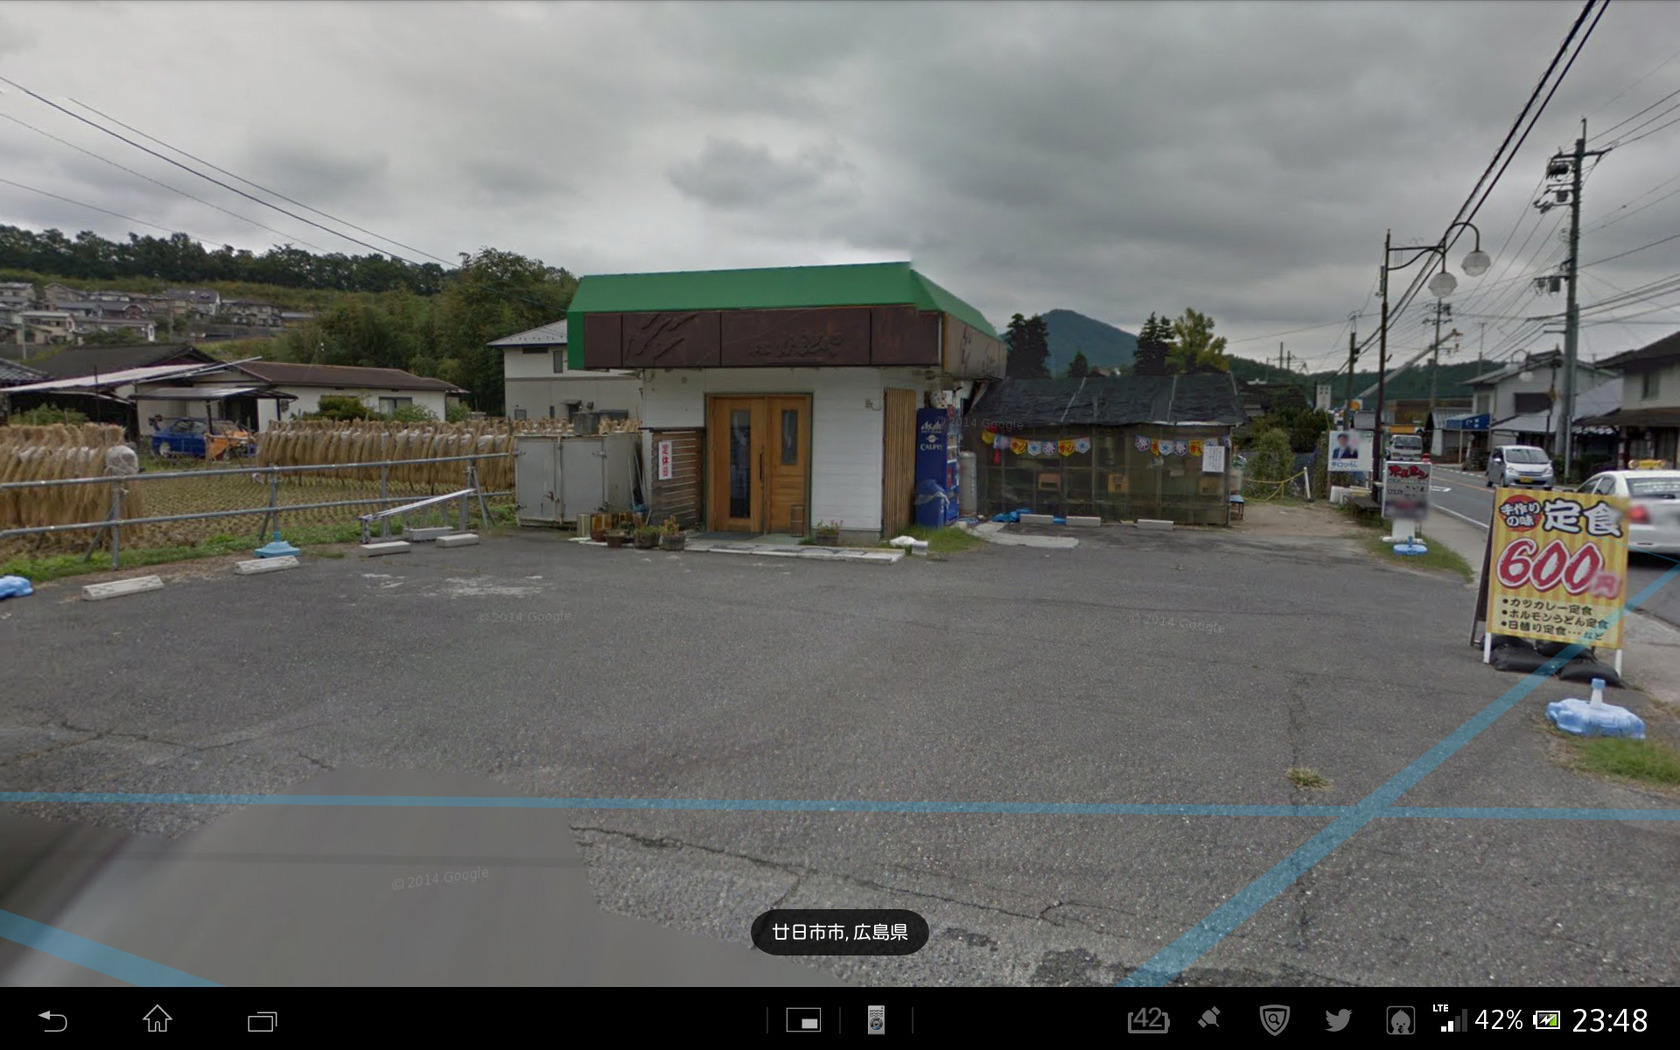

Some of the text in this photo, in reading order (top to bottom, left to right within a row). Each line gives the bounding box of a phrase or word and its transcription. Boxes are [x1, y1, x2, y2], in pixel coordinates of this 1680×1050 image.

[1499, 502, 1541, 516] 手作り
[1505, 515, 1536, 529] の味
[1543, 498, 1623, 538] 定食
[1509, 609, 1609, 630] ホルモンうどん定食
